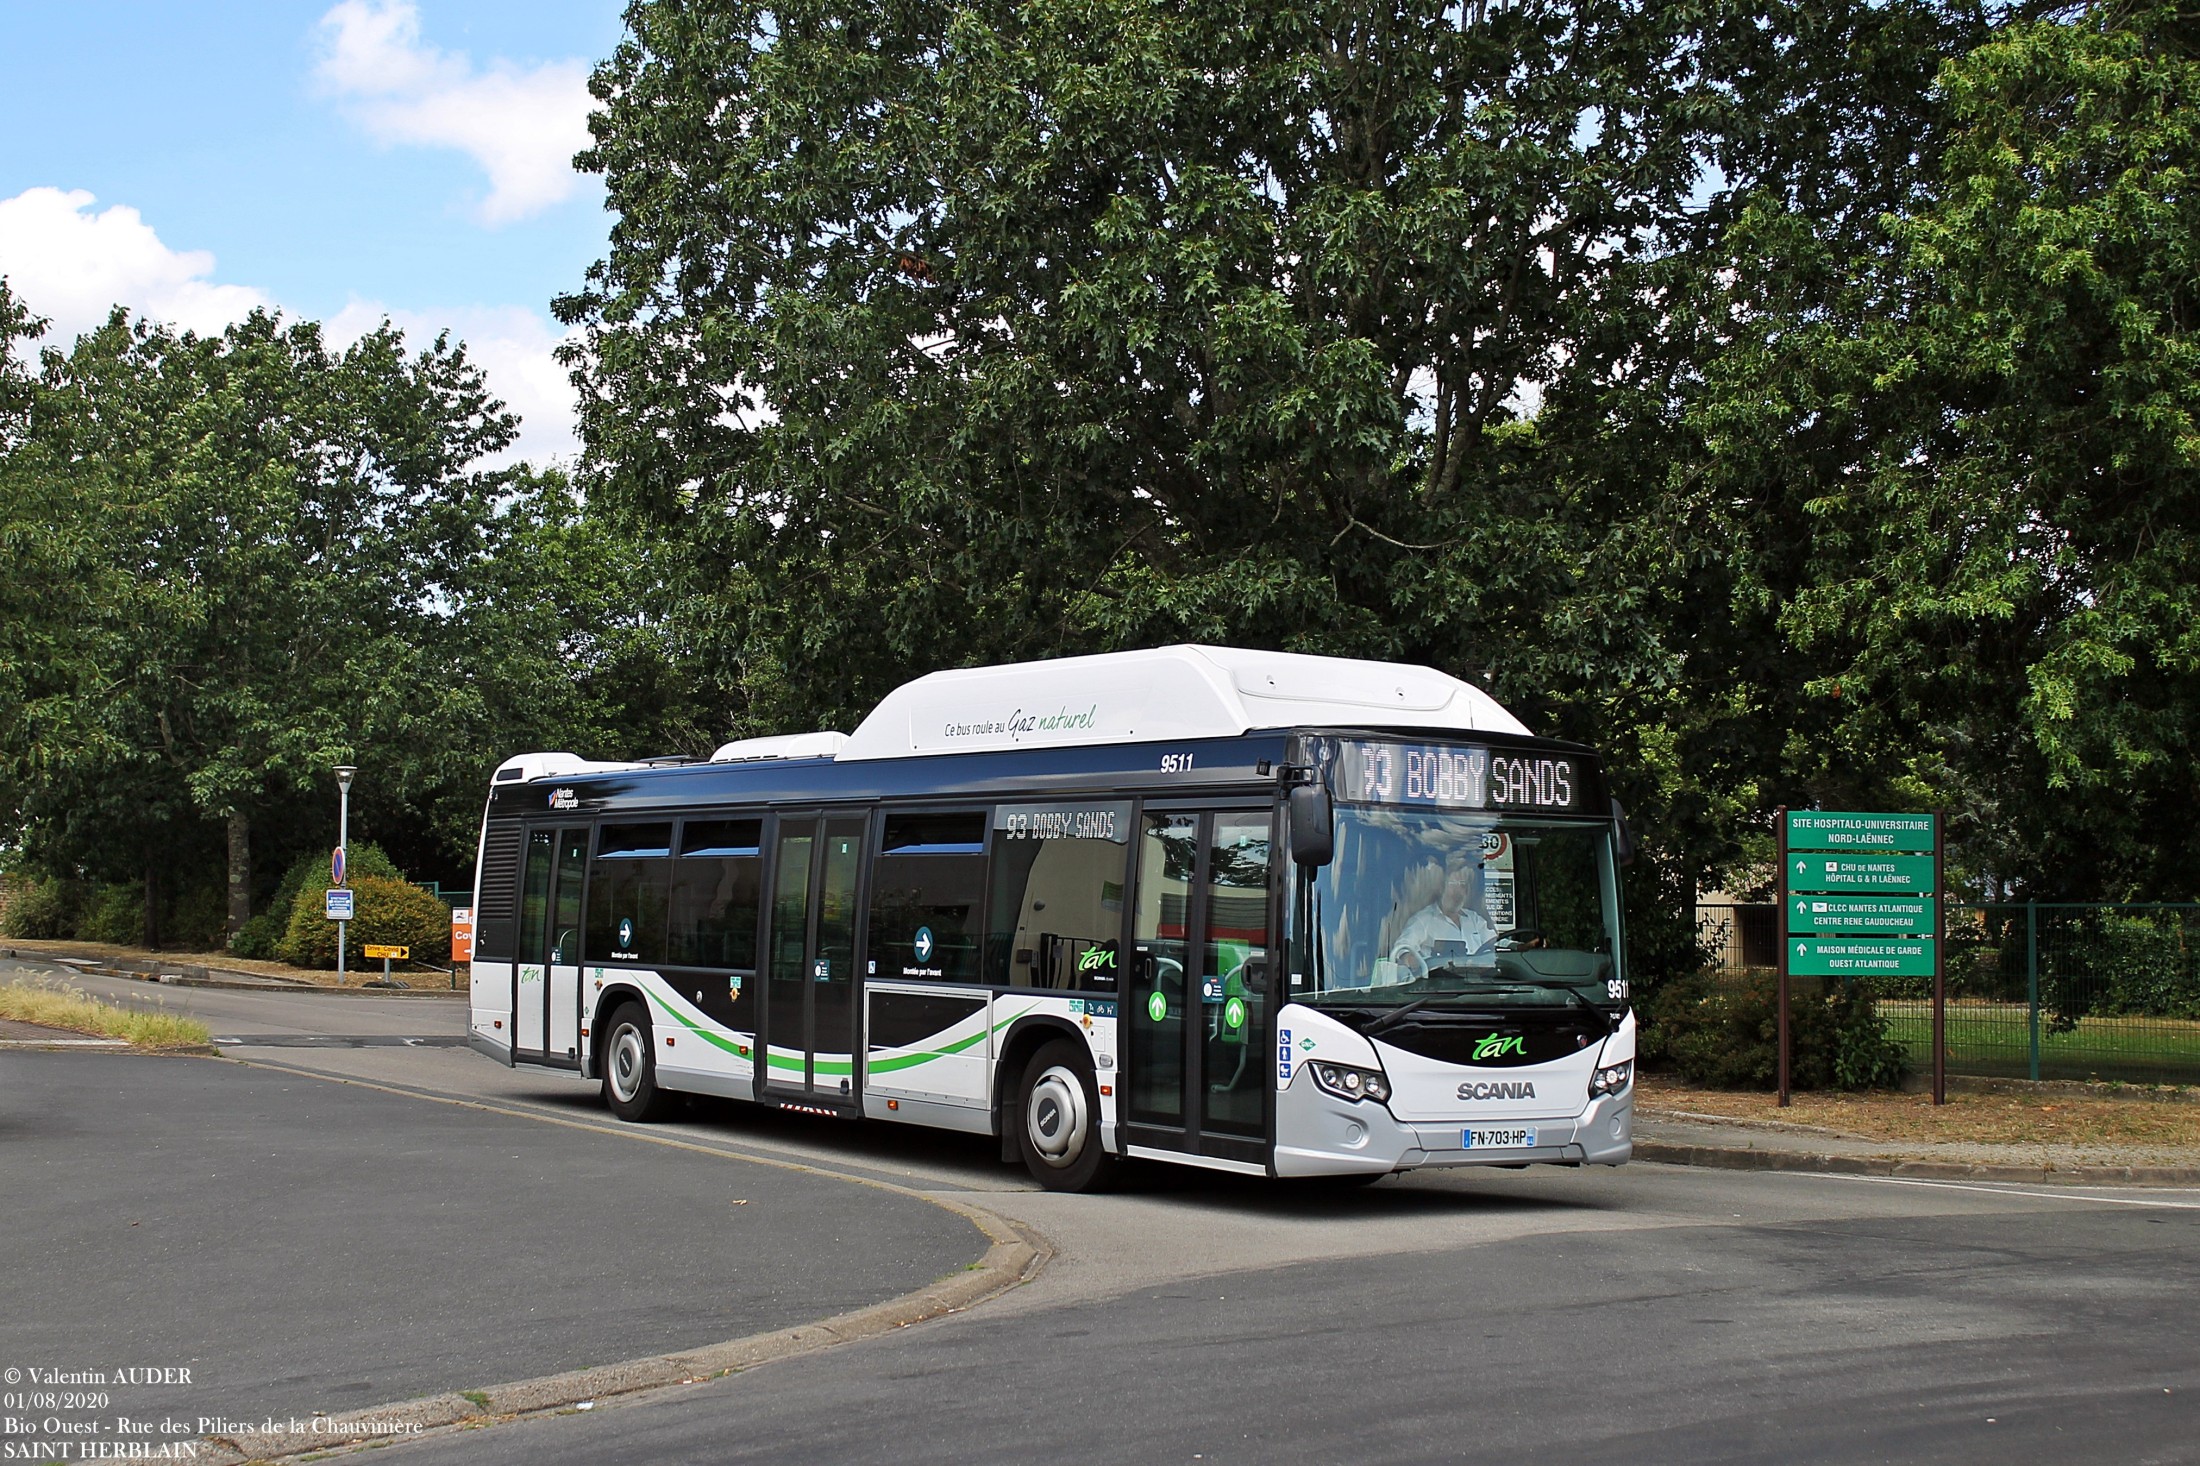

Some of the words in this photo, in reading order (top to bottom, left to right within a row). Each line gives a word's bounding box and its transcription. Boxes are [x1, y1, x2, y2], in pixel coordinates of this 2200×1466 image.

[945, 724, 955, 737] Ce
[956, 721, 970, 736] bus
[971, 720, 993, 735] roule
[994, 723, 1005, 734] au
[1007, 708, 1035, 737] Gaz
[1038, 704, 1097, 731] naturel
[1160, 753, 1194, 774] 9511
[1407, 751, 1485, 801] BOBBY
[1492, 757, 1571, 807] SANDS
[556, 787, 574, 798] Nantes
[1006, 813, 1027, 840] 93
[1032, 812, 1071, 839] BOBBY
[1075, 811, 1115, 839] SANDS
[1792, 818, 1812, 829] SITE
[1814, 819, 1929, 831] HOSPITALO-UNIVERSITAIRE
[1828, 832, 1894, 844] NORD-LAËNNEC
[1841, 863, 1856, 871] CHU
[1867, 864, 1895, 872] NANTES
[1825, 873, 1856, 883] HÔPITAL
[1857, 874, 1863, 883] G
[1864, 875, 1870, 883] &
[1871, 875, 1877, 883] R
[1878, 873, 1911, 884] LAËNNEC
[1828, 903, 1847, 912] CLCC
[1848, 904, 1877, 913] NANTES
[1878, 904, 1923, 913] ATLANTIQUE
[1813, 917, 1842, 925] CENTRE
[1843, 918, 1863, 926] RENE
[1864, 918, 1914, 926] GAUDUCHEAU
[1816, 945, 1846, 954] MAISON
[1847, 944, 1884, 954] MÉDICALE
[1885, 946, 1896, 954] DE
[1897, 946, 1922, 955] GARDE
[1078, 946, 1117, 971] tan
[1829, 959, 1853, 968] OUEST
[1854, 959, 1900, 969] ATLANTIQUE
[521, 966, 541, 984] tan
[903, 967, 919, 975] Montée
[918, 969, 927, 977] par
[1607, 979, 1629, 999] 9511
[1472, 1032, 1528, 1061] tan
[1456, 1081, 1536, 1101] SCANIA
[1470, 1130, 1527, 1145] FN-703-HP
